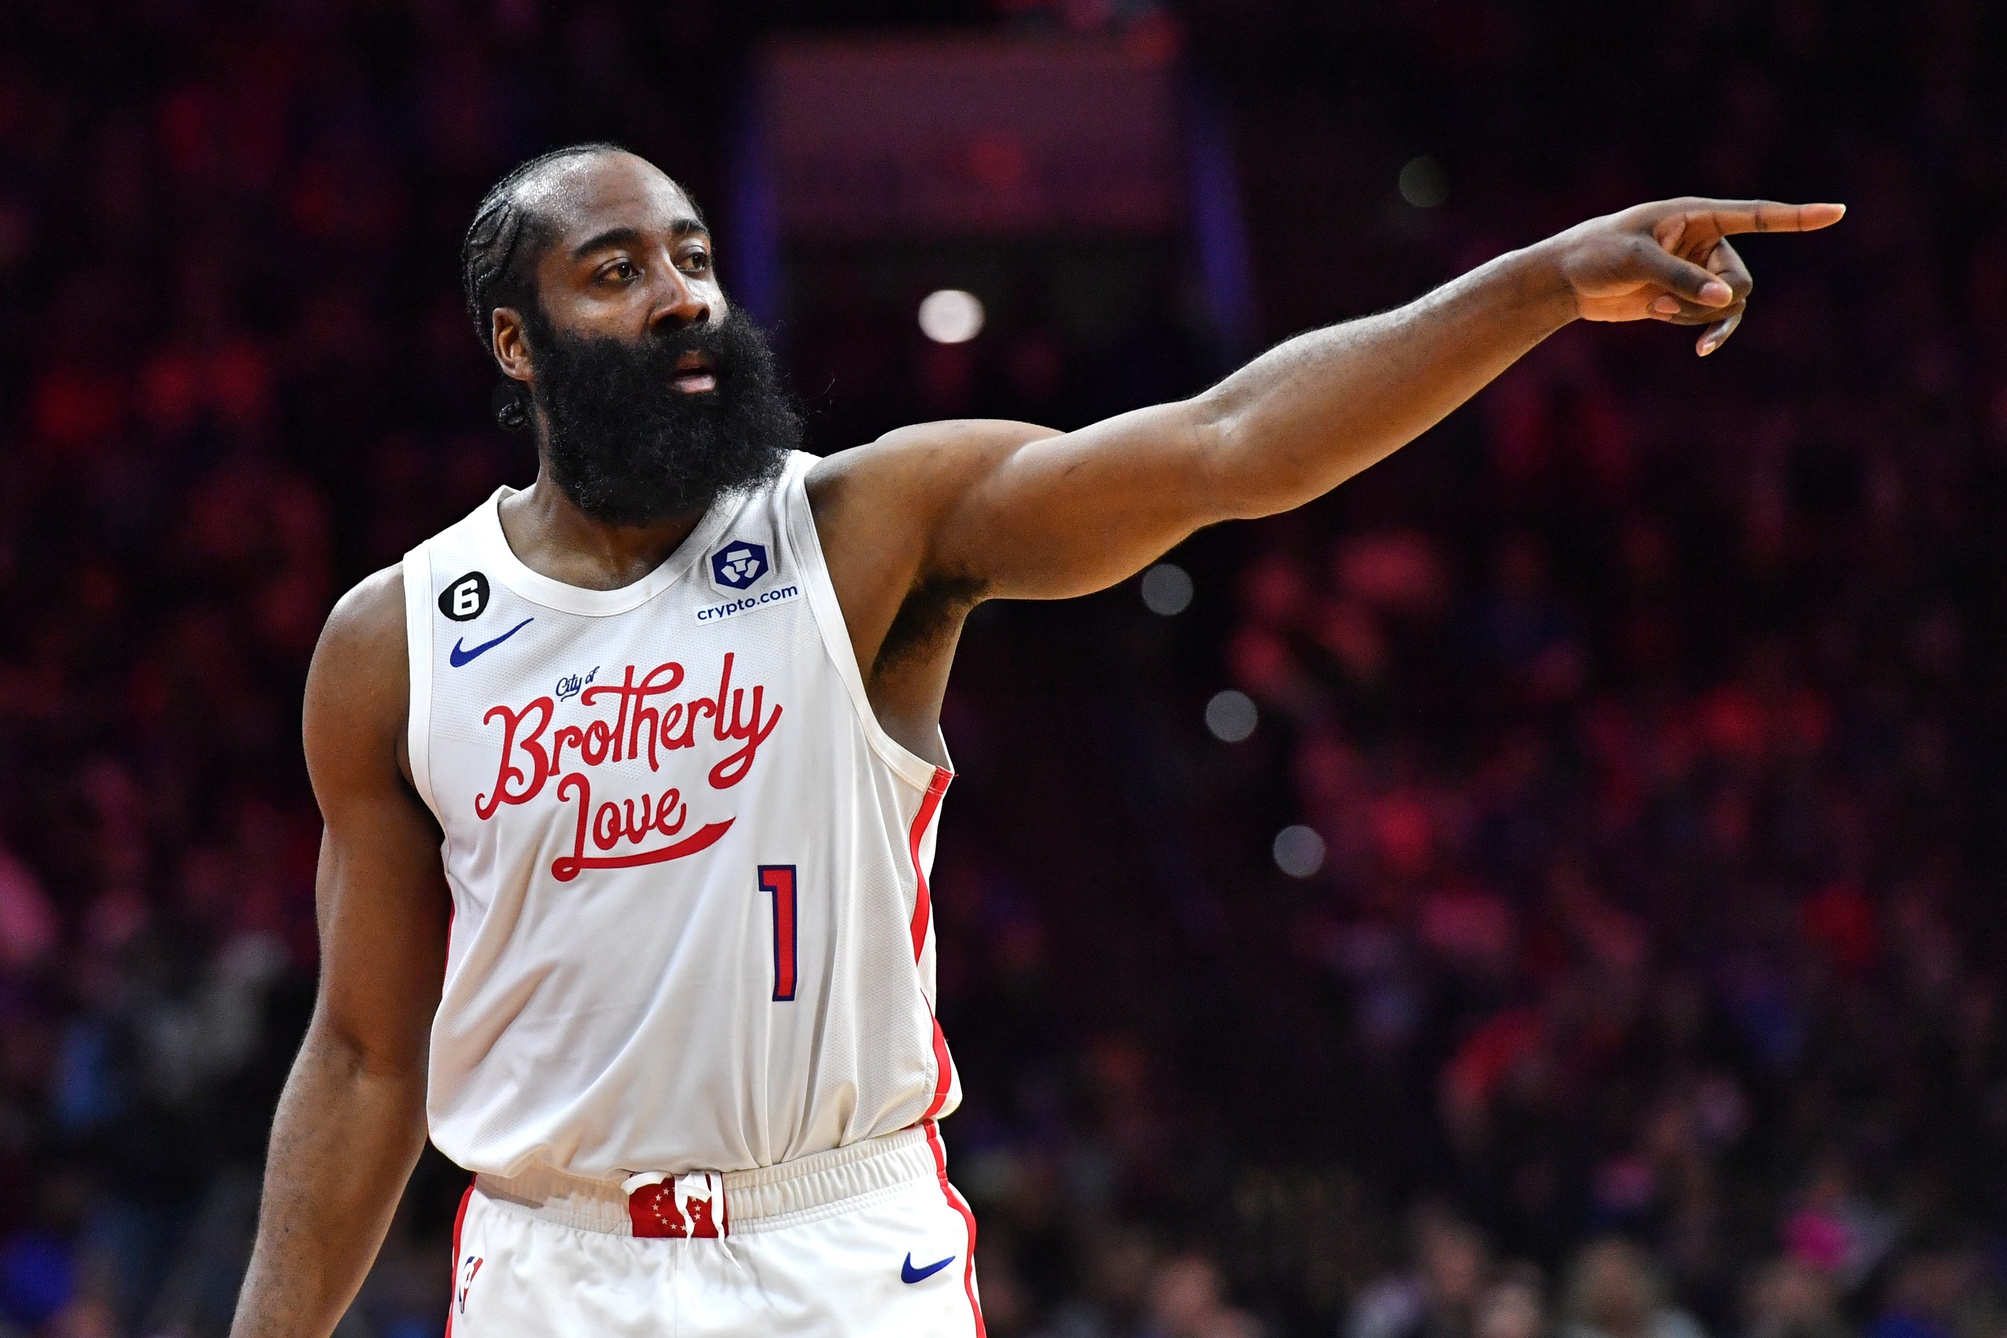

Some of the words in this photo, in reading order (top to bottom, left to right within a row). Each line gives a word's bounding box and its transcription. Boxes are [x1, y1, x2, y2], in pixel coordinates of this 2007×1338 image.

[453, 579, 480, 616] 6
[697, 584, 798, 621] crypto.com
[555, 671, 582, 702] City
[584, 666, 600, 684] of
[475, 652, 783, 820] Brotherly
[550, 772, 736, 882] Love
[758, 865, 797, 1001] 1
